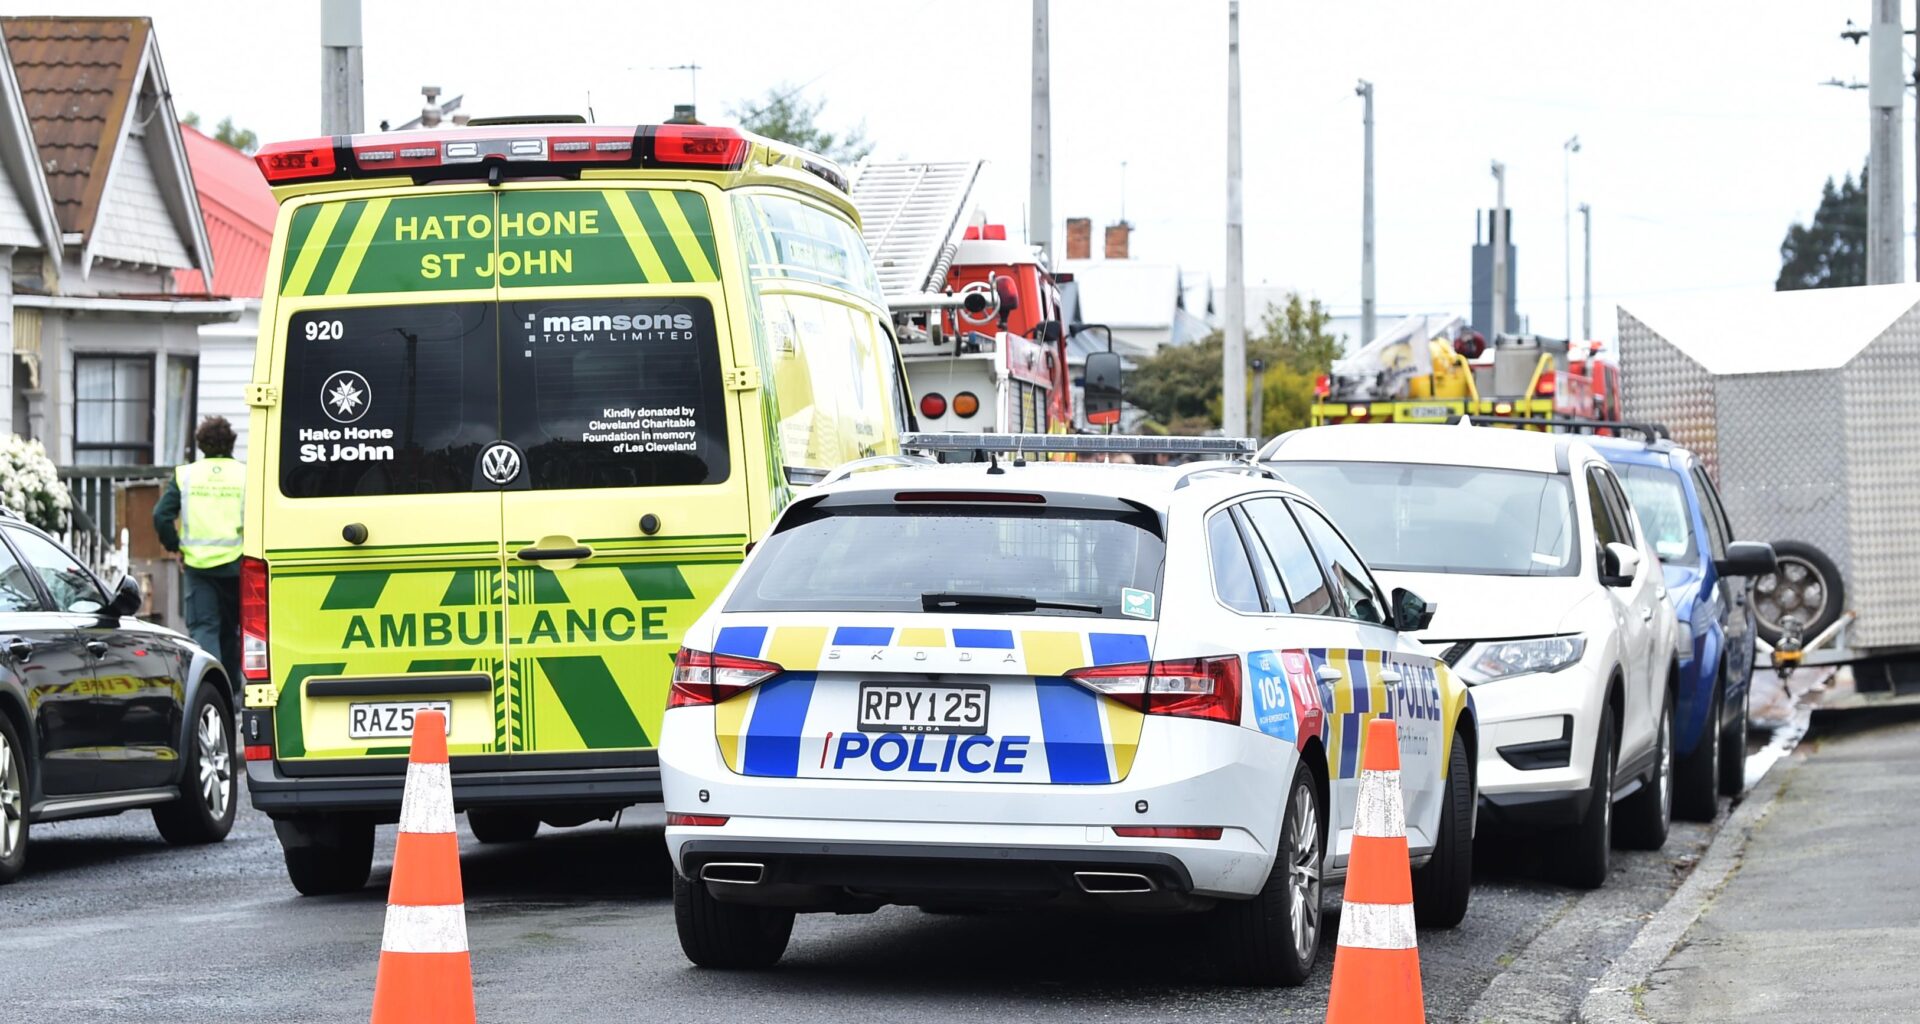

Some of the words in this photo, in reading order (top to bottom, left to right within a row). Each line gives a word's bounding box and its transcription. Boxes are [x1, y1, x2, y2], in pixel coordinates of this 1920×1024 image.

[395, 214, 492, 241] HATO
[501, 210, 599, 237] HONE
[420, 253, 465, 279] ST
[475, 249, 573, 277] JOHN
[305, 320, 344, 341] 920
[543, 314, 693, 332] mansons
[543, 333, 594, 343] TCLM
[610, 331, 693, 341] LIMITED
[603, 408, 636, 419] Kindly
[637, 406, 680, 417] donated
[682, 406, 695, 417] by
[299, 428, 341, 441] Hato
[344, 427, 394, 440] Hone
[589, 419, 640, 430] Cleveland
[641, 418, 696, 429] Charitable
[582, 431, 640, 442] Foundation
[641, 431, 651, 440] in
[653, 431, 696, 441] memory
[613, 443, 625, 453] of
[625, 443, 644, 453] Les
[645, 441, 697, 452] Cleveland
[300, 443, 327, 463] St
[330, 442, 394, 462] John
[341, 606, 669, 649] AMBULANCE
[828, 650, 1017, 663] SKODA
[1258, 676, 1285, 711] 105
[1393, 661, 1440, 721] POLICE
[865, 691, 981, 722] RPY125
[353, 707, 447, 732] RAZ5
[833, 731, 1031, 774] POLICE
